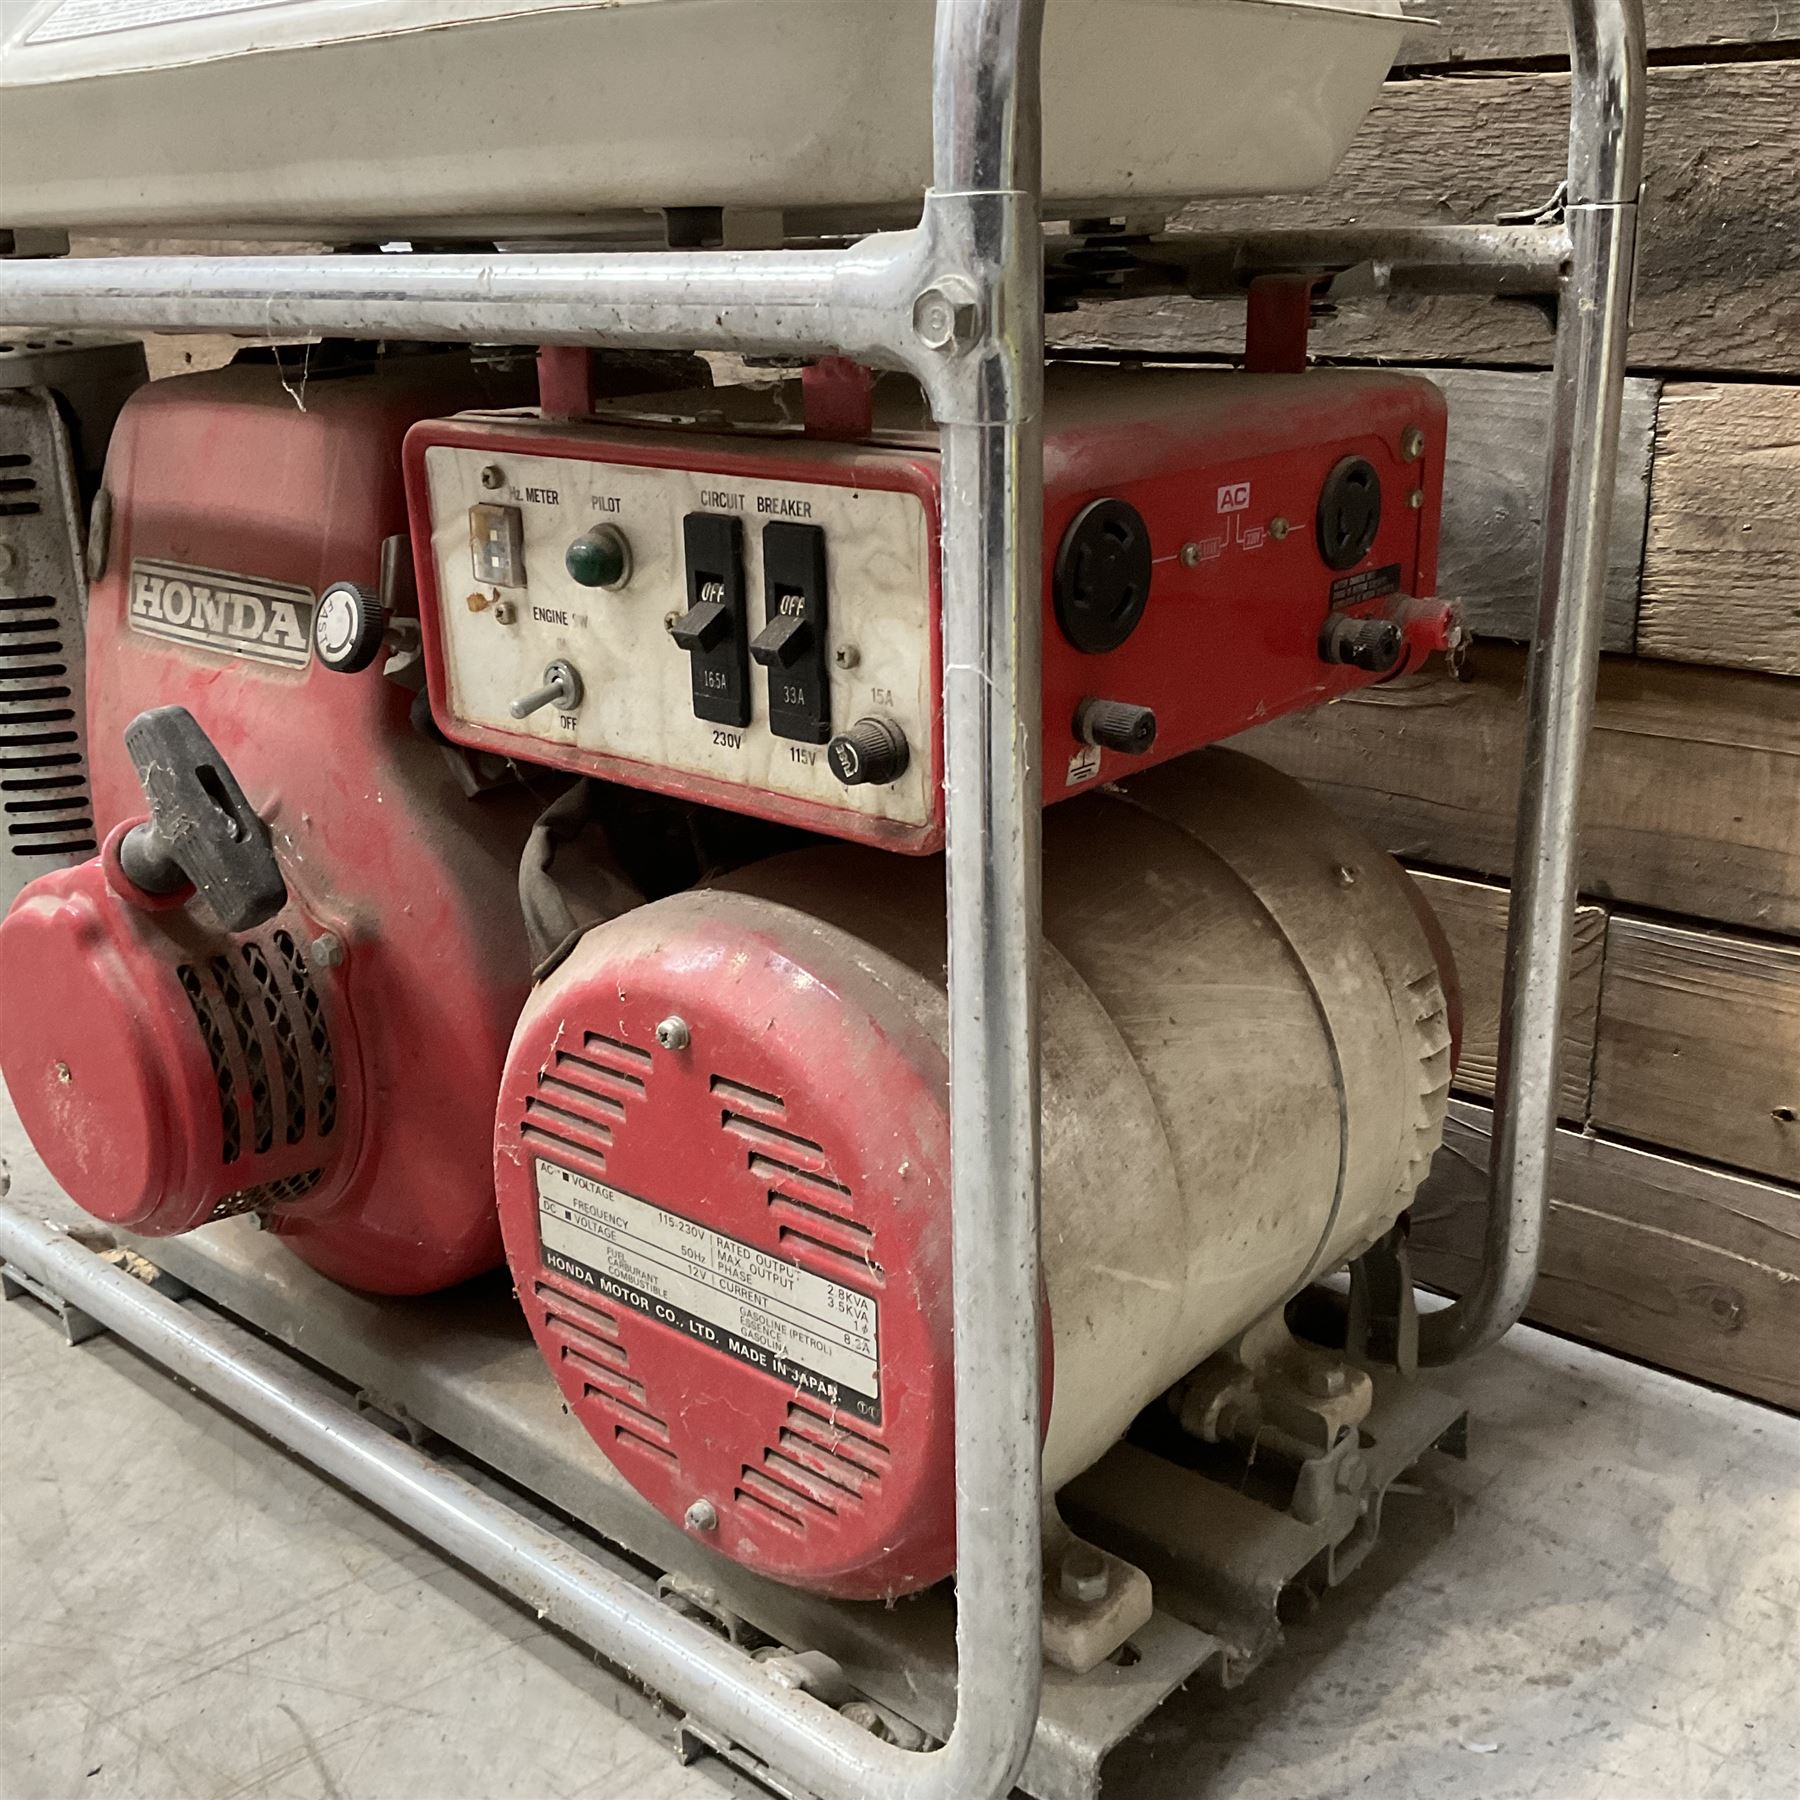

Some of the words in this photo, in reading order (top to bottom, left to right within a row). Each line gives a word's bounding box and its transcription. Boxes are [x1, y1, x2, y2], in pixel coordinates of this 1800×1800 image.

[525, 487, 560, 505] METER
[591, 495, 622, 514] PILOT
[700, 490, 745, 510] CIRCUIT
[757, 496, 812, 518] BREAKER
[1221, 487, 1248, 509] AC
[701, 582, 725, 602] OFF
[780, 595, 805, 616] OFF
[132, 573, 307, 649] HONDA
[318, 599, 334, 645] FAST
[533, 606, 569, 626] ENGINE
[783, 686, 805, 705] 33A
[871, 687, 894, 708] 15A
[560, 715, 577, 731] OFF
[712, 730, 742, 750] 230V
[790, 746, 816, 767] 115V
[835, 744, 854, 778] FUSE
[571, 1174, 615, 1202] VOLTAGE
[544, 1200, 556, 1213] DC
[574, 1213, 617, 1242] VOLTAGE
[687, 1264, 707, 1281] 12V
[573, 1198, 629, 1231] FREQUENCY
[681, 1245, 706, 1264] 50Hz
[606, 1246, 626, 1263] FUEL
[716, 1237, 751, 1260] RATED
[756, 1254, 801, 1281] OUTPUT
[607, 1256, 659, 1285] CARBURANT
[608, 1265, 668, 1299] COMBUSTIBLE
[717, 1261, 752, 1286] PHASE
[749, 1263, 794, 1291] OUTPUT
[719, 1278, 768, 1308] CURRENT
[547, 1253, 595, 1285] HONDA
[600, 1278, 649, 1311] MOTOR
[655, 1304, 684, 1328] CO.,
[689, 1319, 720, 1344] LTD.
[728, 1338, 767, 1367] MADE
[773, 1359, 787, 1376] IN
[740, 1316, 782, 1342] ESSENCE
[740, 1306, 787, 1336] GASOLINE
[789, 1328, 832, 1356] (PETROL)
[741, 1327, 789, 1356] GASOLINA
